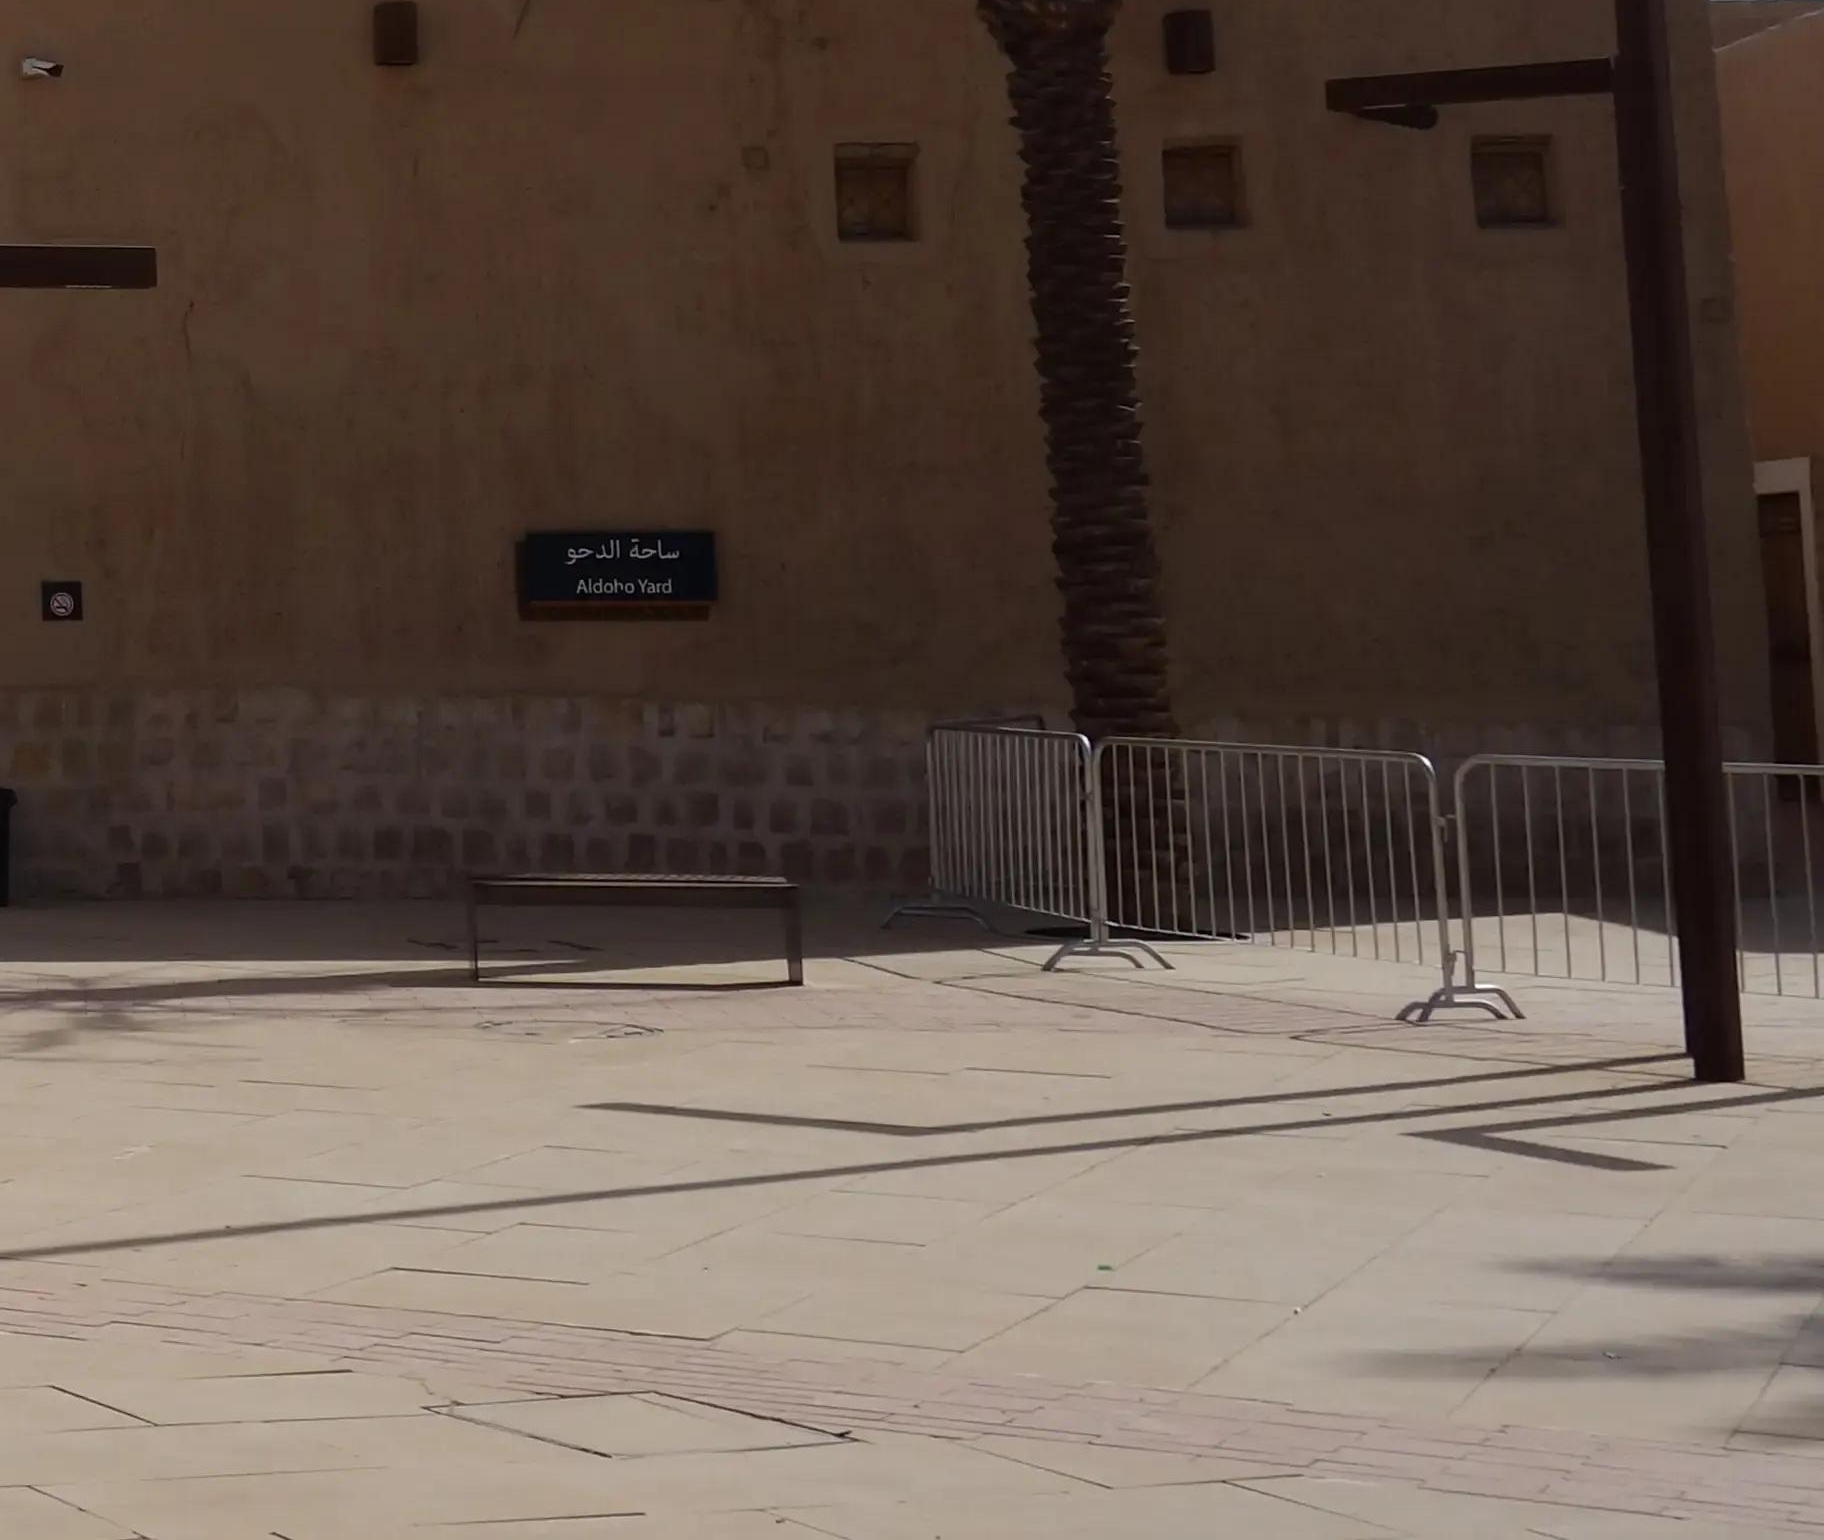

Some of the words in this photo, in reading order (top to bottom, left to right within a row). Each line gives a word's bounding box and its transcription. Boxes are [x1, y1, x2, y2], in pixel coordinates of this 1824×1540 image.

[564, 539, 621, 565] الدحو
[628, 537, 681, 560] ساحة
[575, 578, 635, 595] Aldoho
[638, 578, 673, 595] Yard
